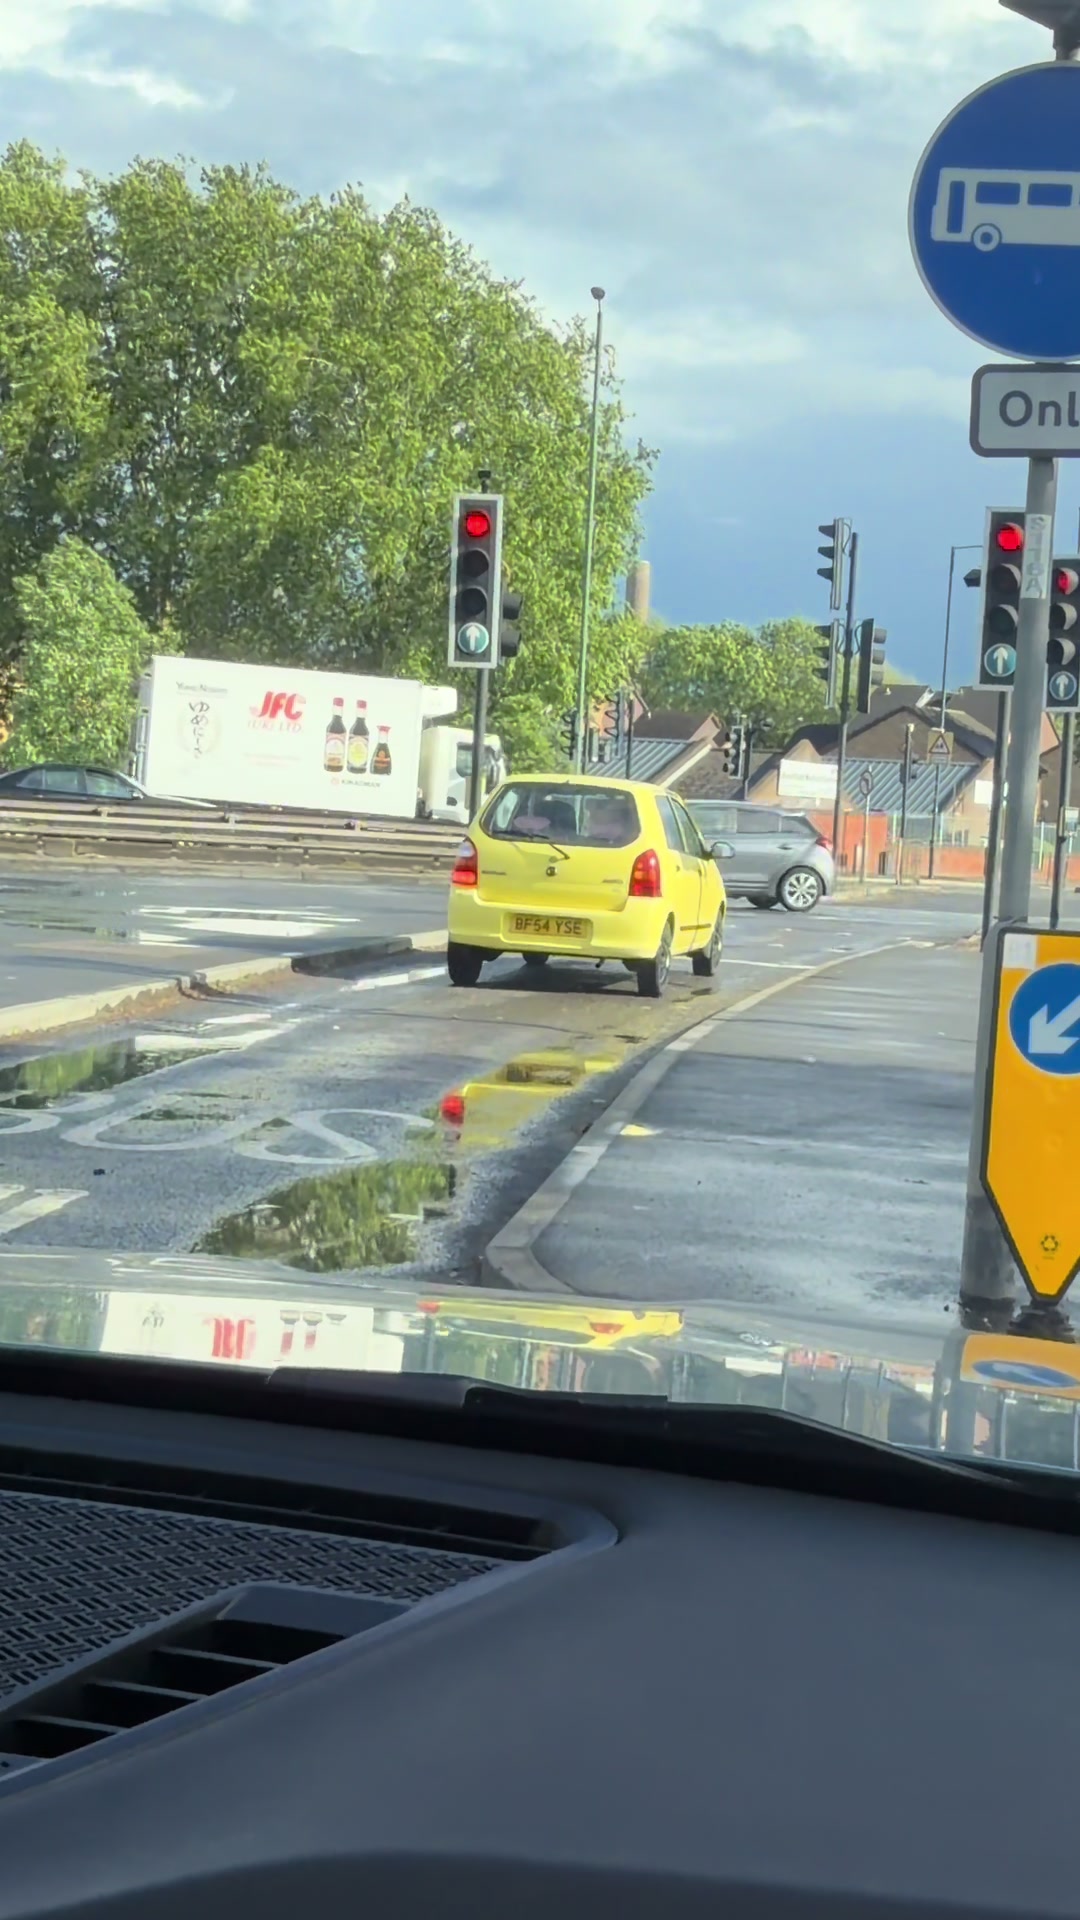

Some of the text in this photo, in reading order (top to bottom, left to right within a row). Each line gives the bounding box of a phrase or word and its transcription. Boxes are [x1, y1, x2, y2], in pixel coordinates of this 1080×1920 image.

[999, 390, 1080, 427] Onl
[249, 691, 307, 720] JFC
[515, 917, 582, 935] BF54 YSE
